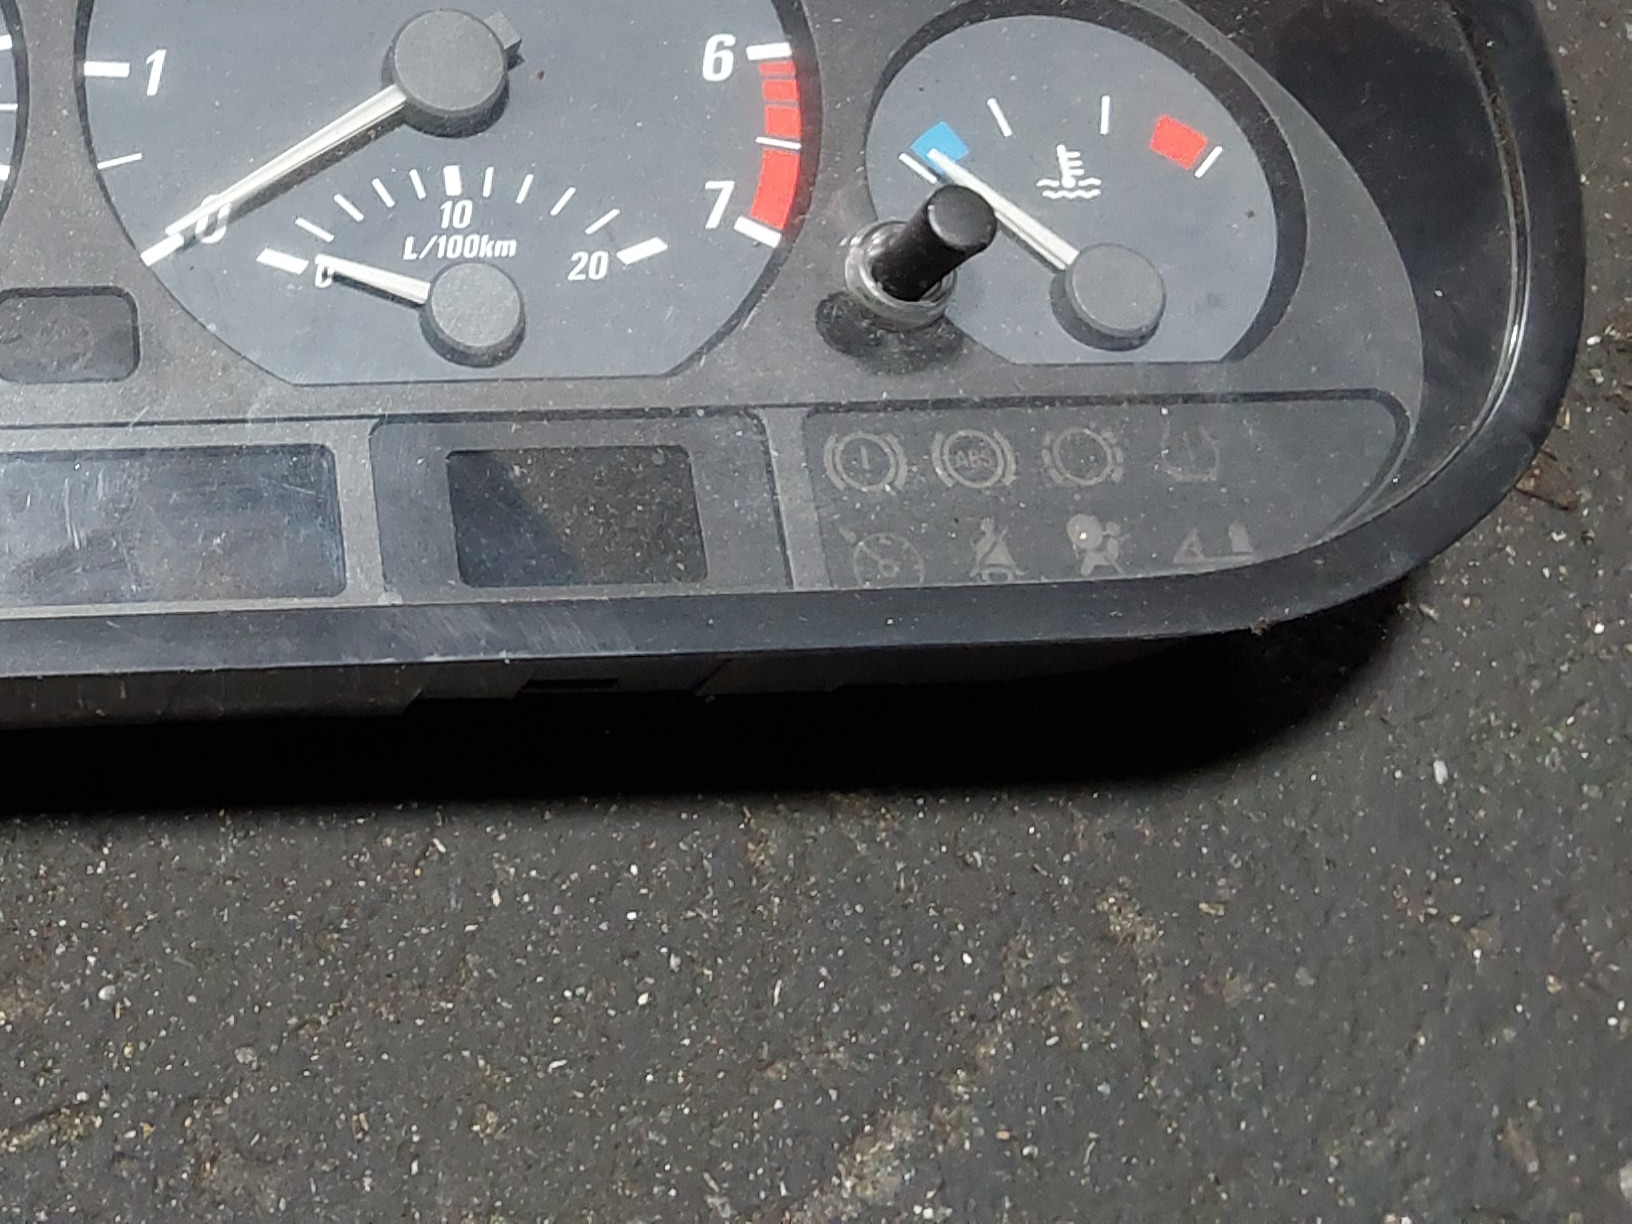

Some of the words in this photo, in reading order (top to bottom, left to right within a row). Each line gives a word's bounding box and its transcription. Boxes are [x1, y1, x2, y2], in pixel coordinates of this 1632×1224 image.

[145, 49, 167, 96] 1
[702, 33, 736, 80] 6
[439, 201, 472, 229] 10
[704, 180, 736, 229] 7
[403, 233, 516, 260] L/100km
[567, 252, 609, 279] 20
